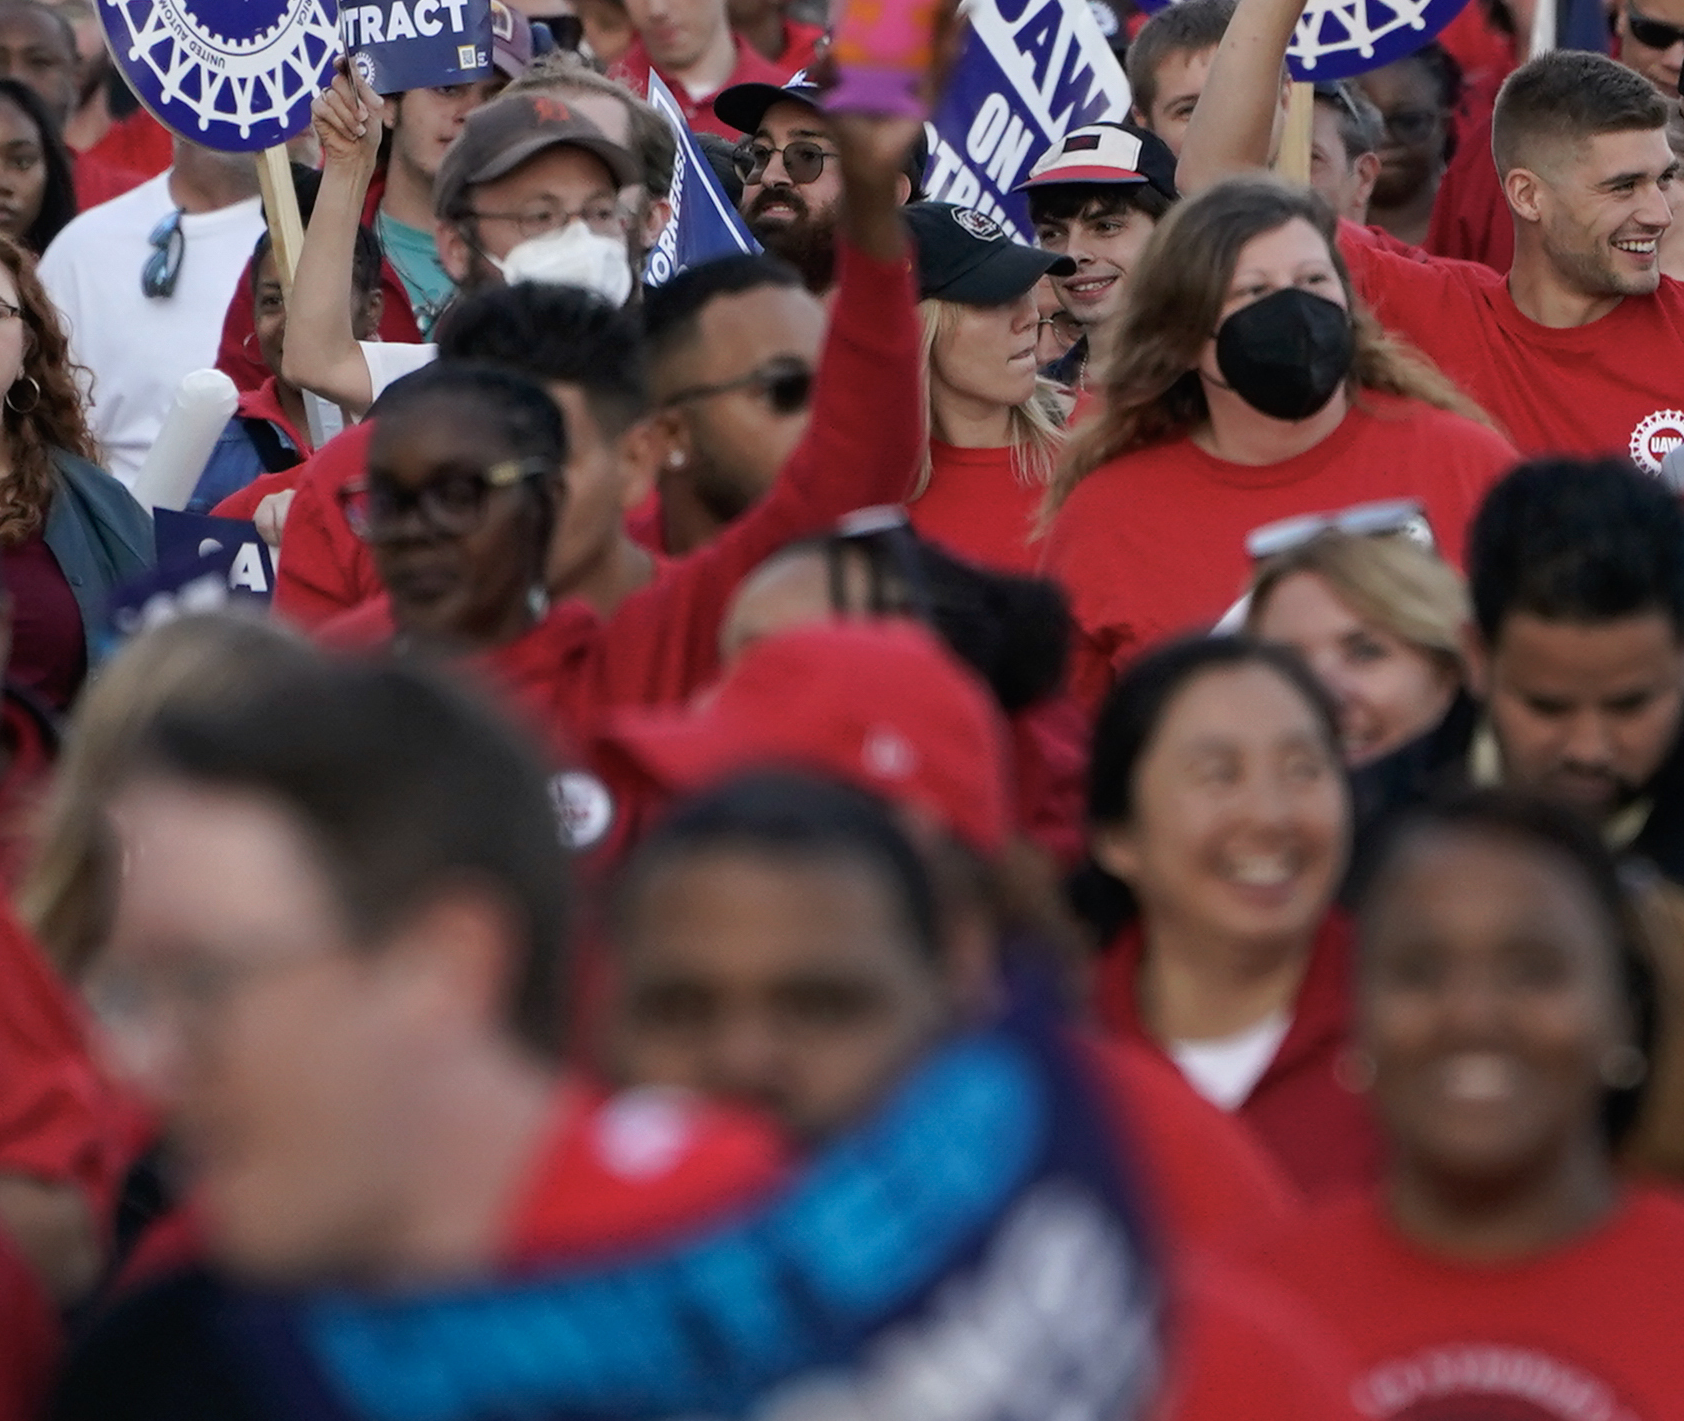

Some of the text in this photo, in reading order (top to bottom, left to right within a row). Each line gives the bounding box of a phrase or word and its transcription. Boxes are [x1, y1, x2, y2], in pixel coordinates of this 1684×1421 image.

[188, 41, 226, 70] UNITED
[965, 91, 1035, 196] ON
[646, 141, 687, 288] ORKERS!
[1650, 436, 1684, 454] UAW
